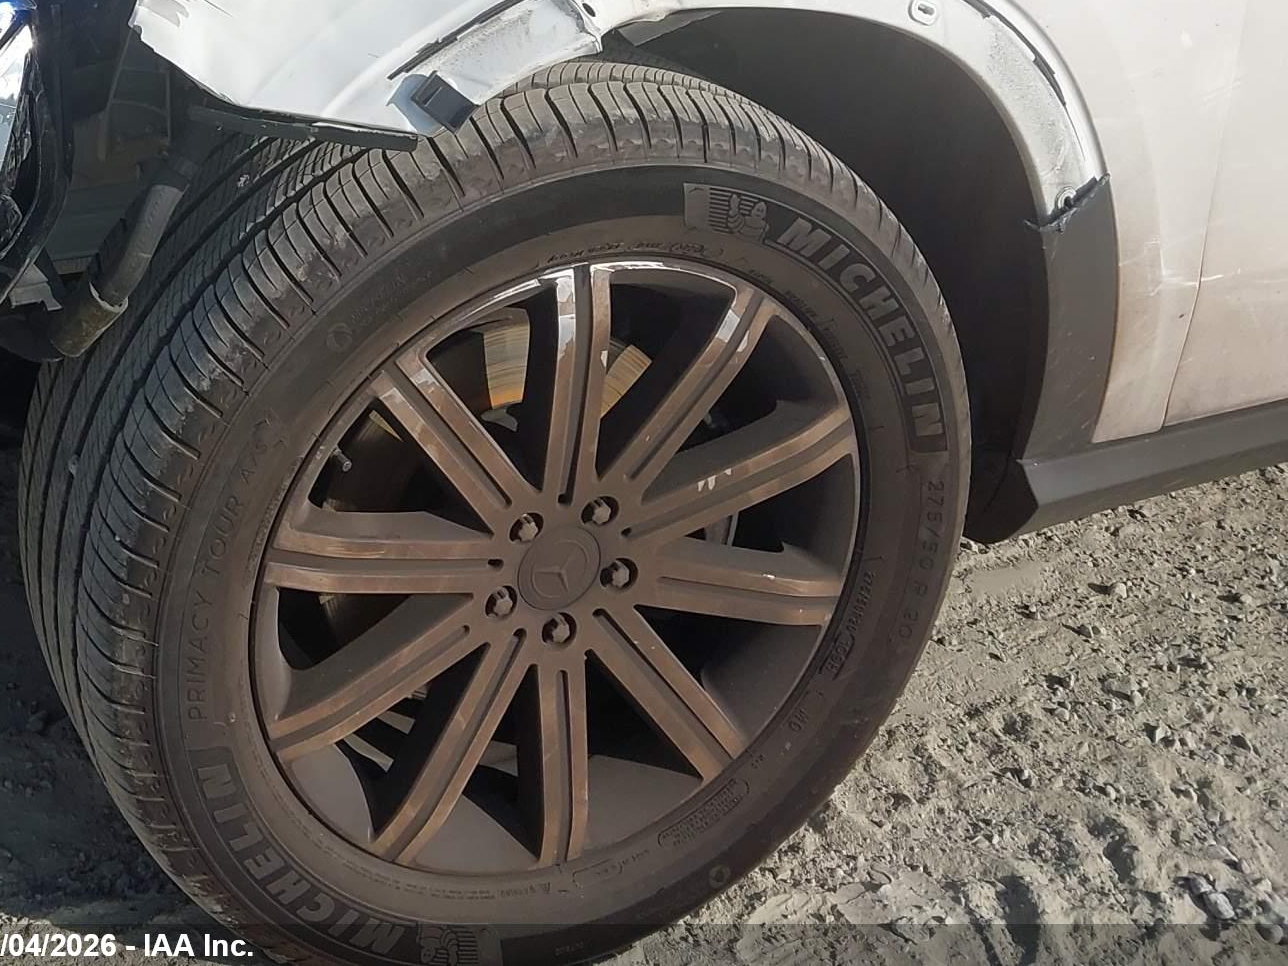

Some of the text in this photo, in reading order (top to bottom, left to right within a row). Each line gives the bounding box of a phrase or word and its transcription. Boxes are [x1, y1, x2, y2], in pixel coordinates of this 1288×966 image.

[776, 216, 945, 436] MICHELIN
[200, 495, 244, 576] TOUR
[918, 480, 945, 571] 275/50
[188, 592, 213, 721] PRIMACY
[196, 763, 406, 962] MICHELIN
